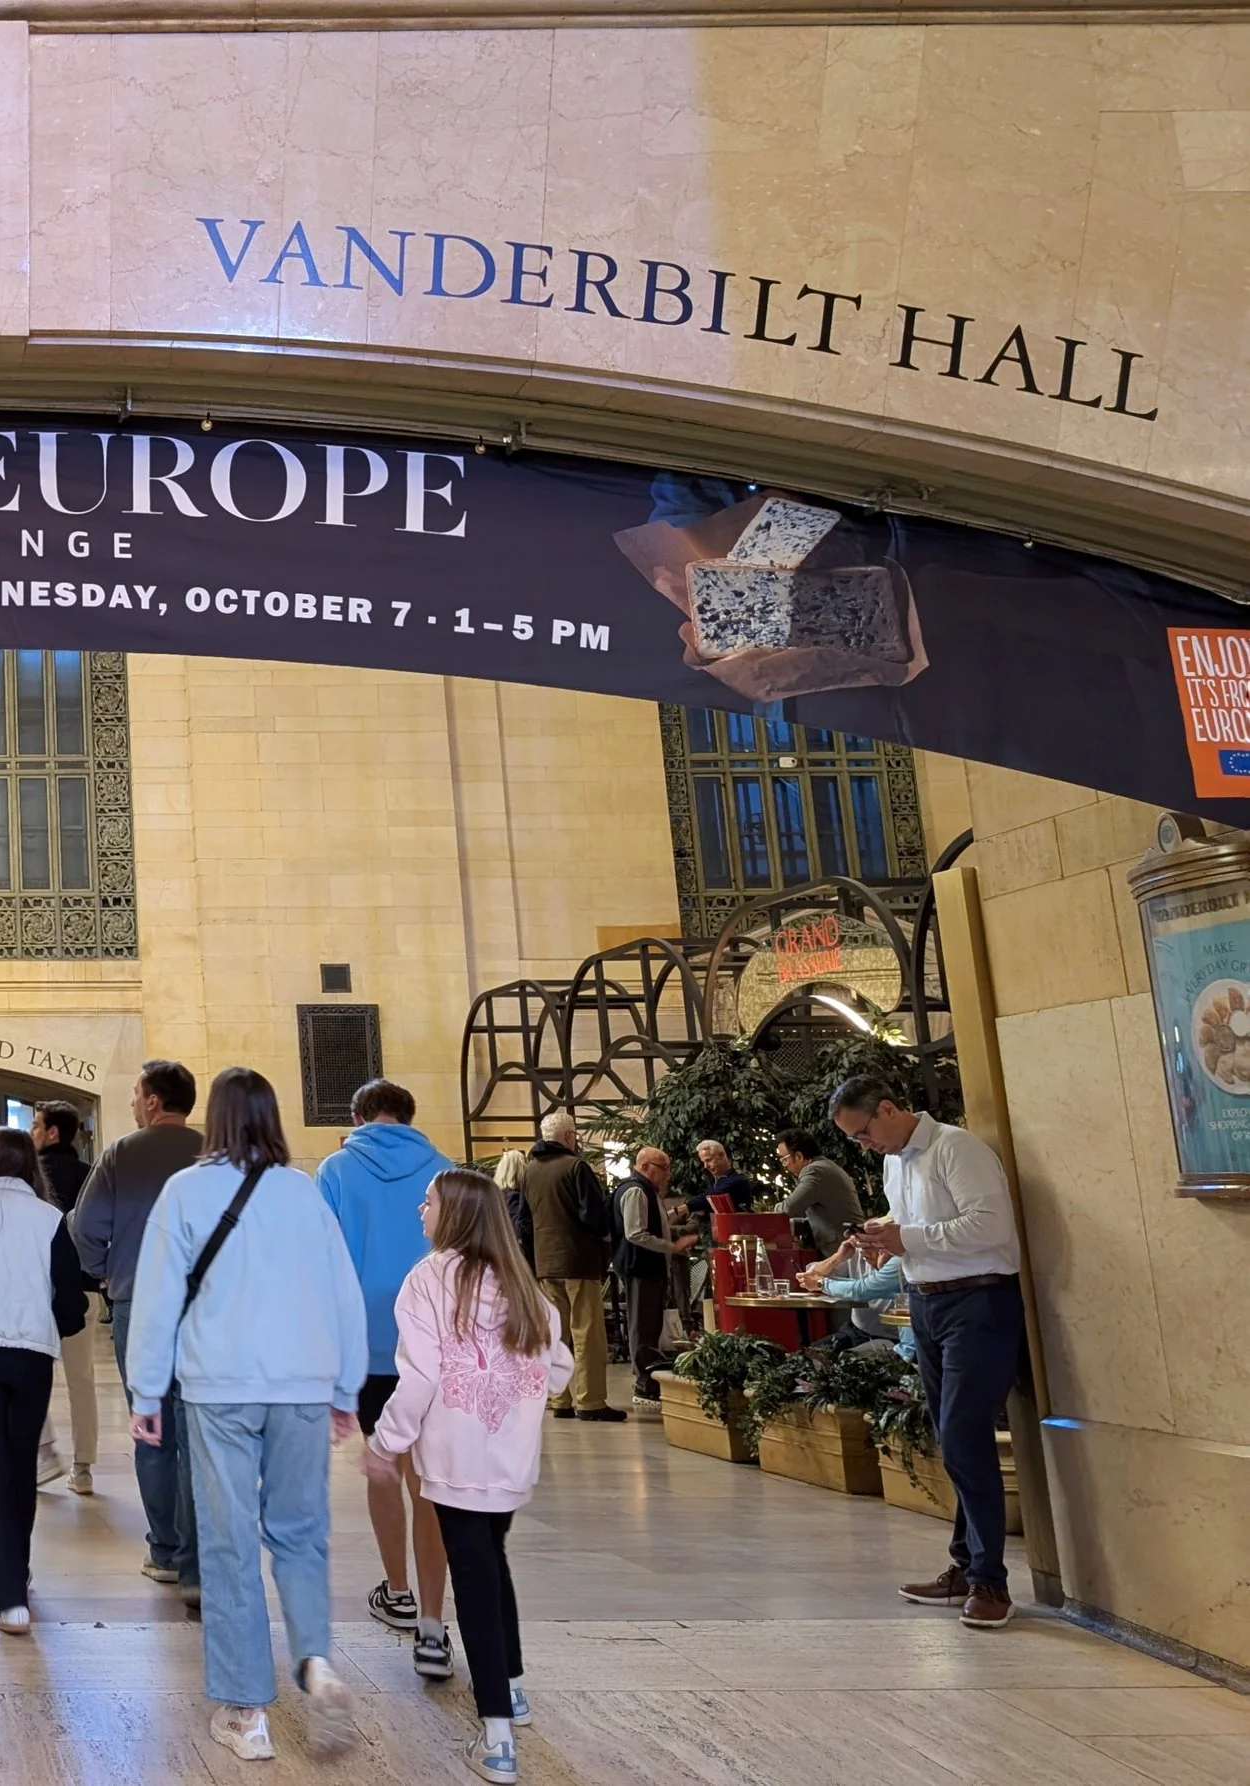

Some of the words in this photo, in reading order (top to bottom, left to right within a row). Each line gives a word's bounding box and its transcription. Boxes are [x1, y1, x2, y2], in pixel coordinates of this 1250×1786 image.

[195, 217, 862, 355] VANDERBILT
[889, 303, 1160, 422] HALL
[185, 586, 373, 624] OCTOBER
[391, 600, 412, 627] 7
[551, 618, 610, 652] PM
[1186, 678, 1220, 708] IT'S
[774, 914, 840, 957] GRAND
[1203, 941, 1235, 957] MAKE
[26, 1046, 97, 1082] TAXIS
